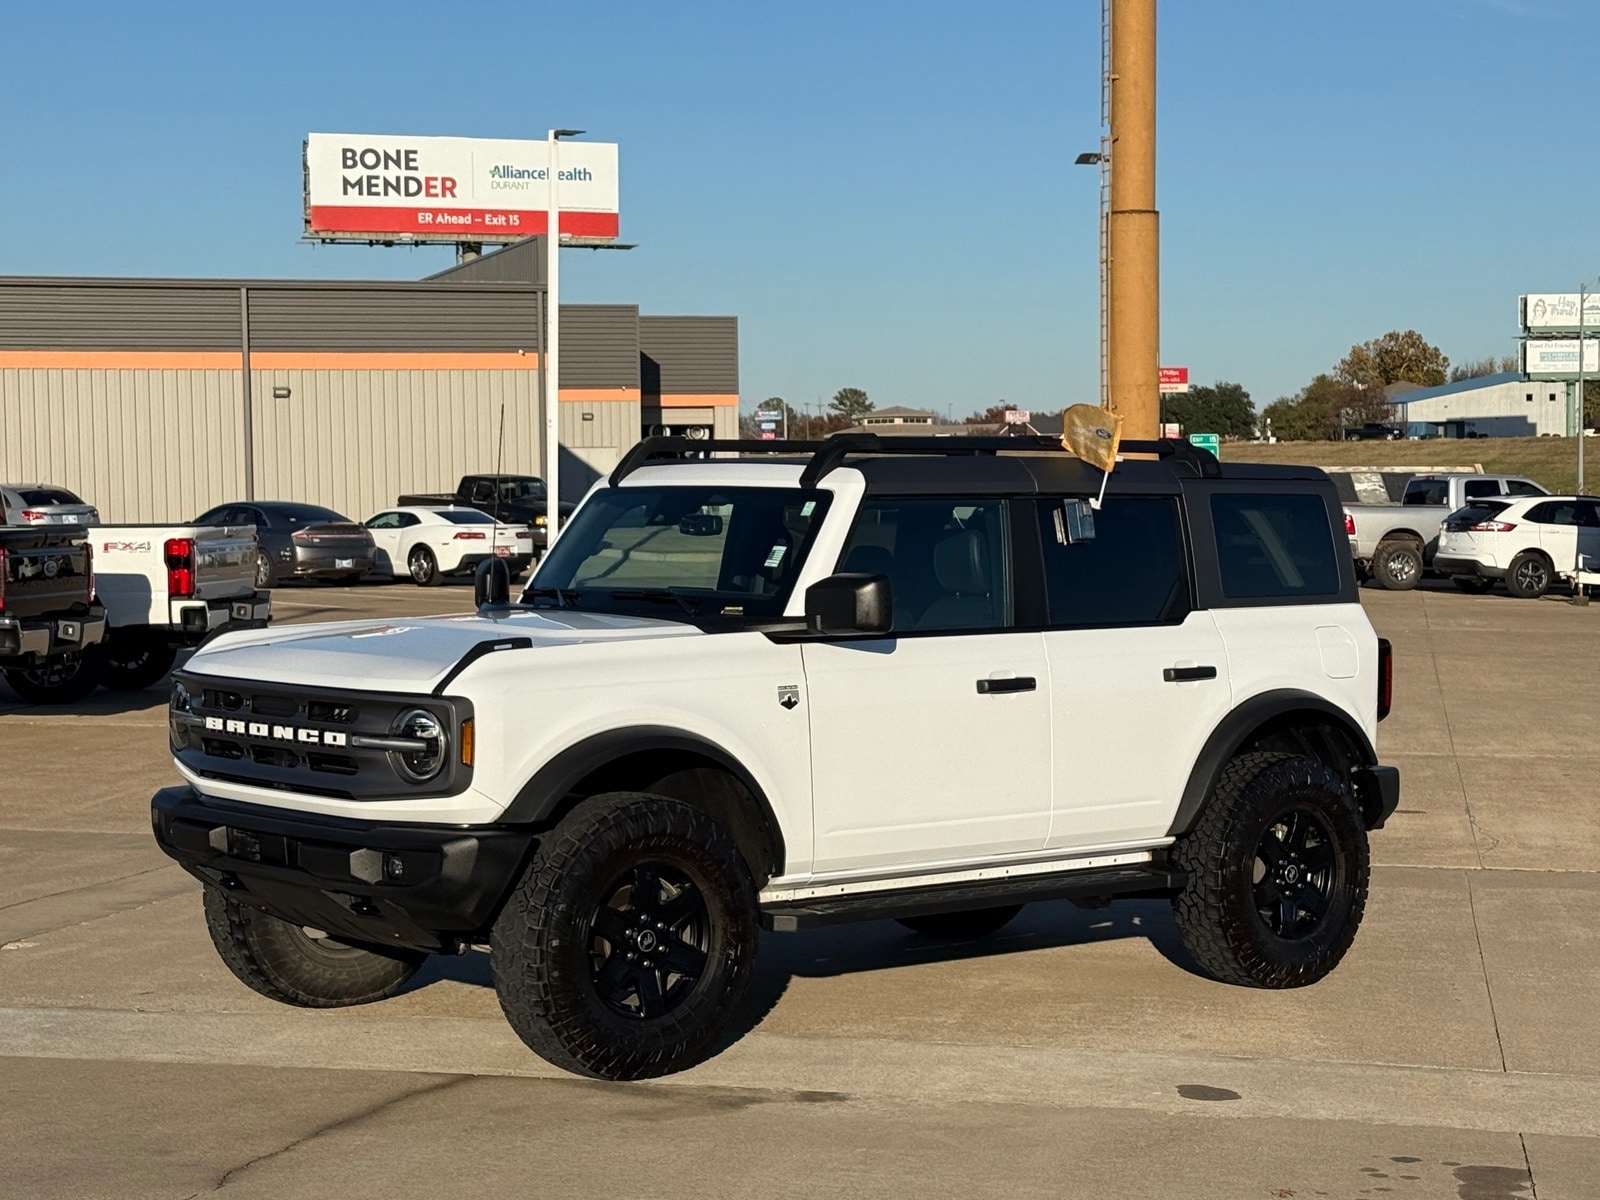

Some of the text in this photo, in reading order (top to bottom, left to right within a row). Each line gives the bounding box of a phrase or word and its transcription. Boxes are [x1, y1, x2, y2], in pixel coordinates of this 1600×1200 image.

[341, 148, 419, 171] BONE
[342, 174, 457, 198] MENDER
[490, 180, 529, 190] DURANT
[417, 212, 433, 224] ER
[435, 212, 472, 225] Ahead
[484, 213, 507, 226] Exit
[508, 214, 520, 226] 15
[103, 541, 151, 553] FX4
[205, 716, 347, 747] BRONCO
